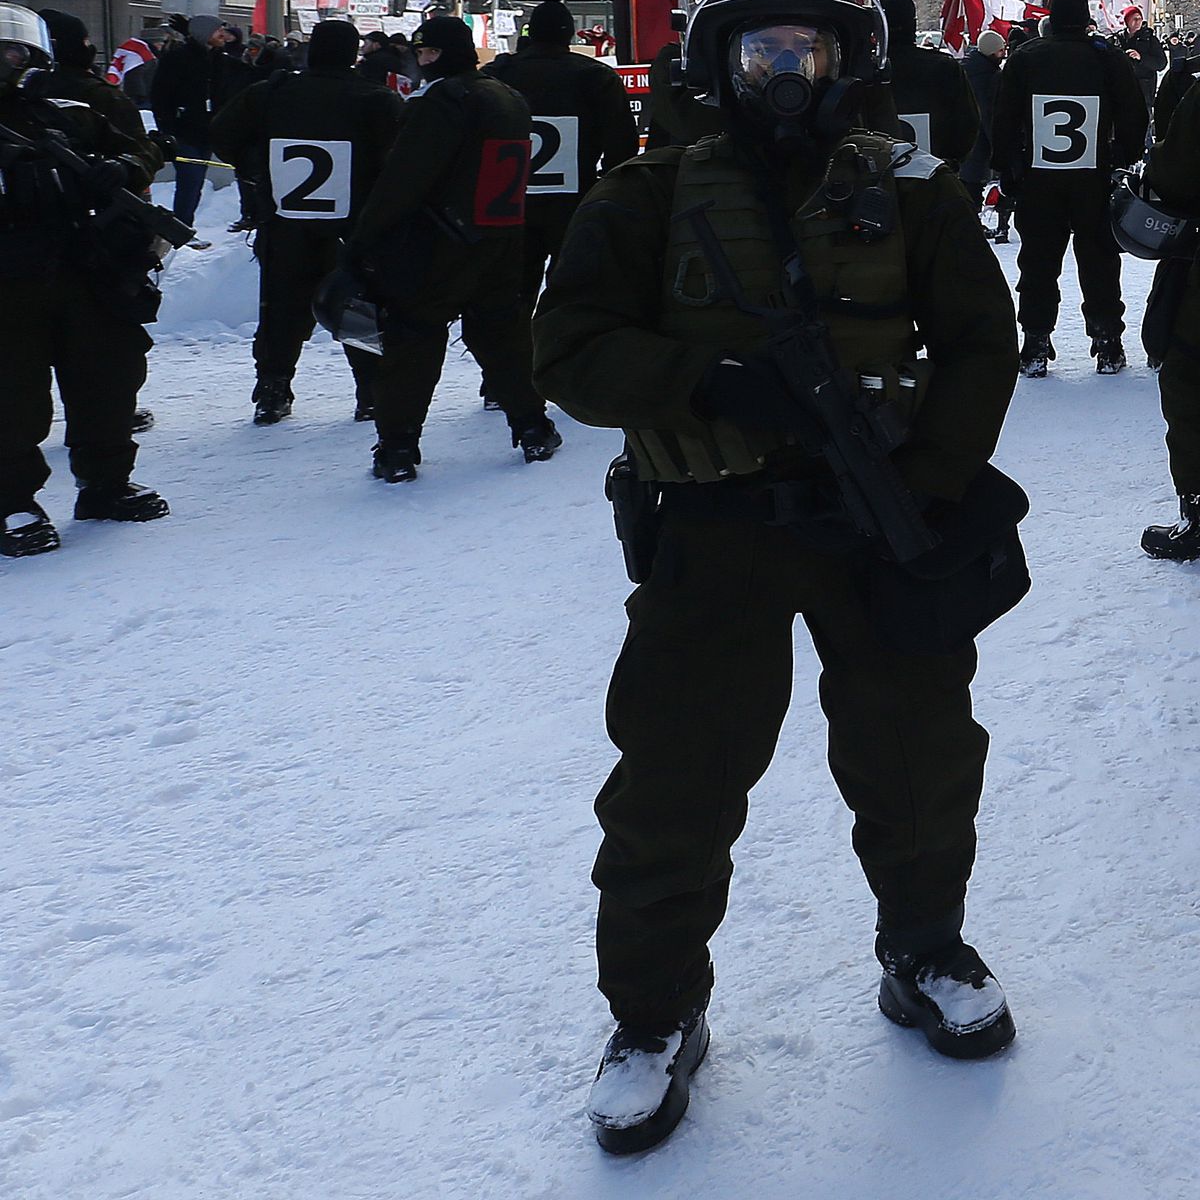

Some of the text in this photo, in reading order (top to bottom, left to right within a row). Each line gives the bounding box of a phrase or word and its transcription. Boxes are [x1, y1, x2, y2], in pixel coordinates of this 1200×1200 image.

[527, 119, 566, 186] 2
[1040, 98, 1088, 163] 3
[280, 143, 336, 213] 2
